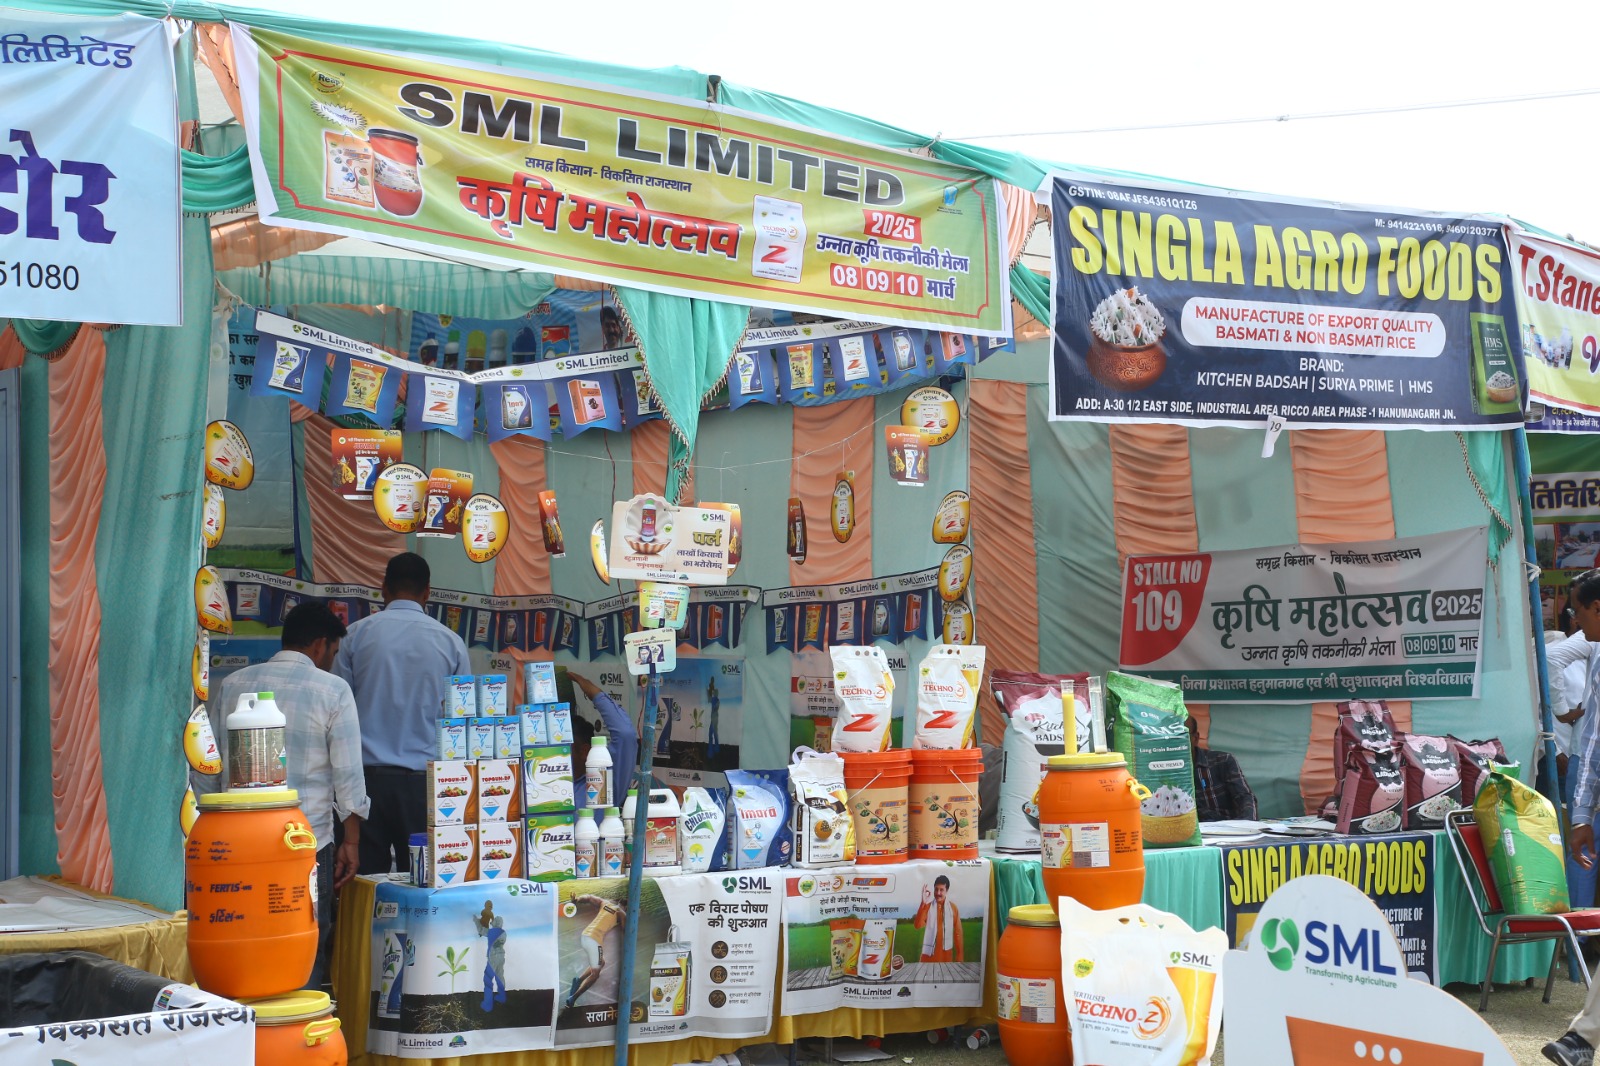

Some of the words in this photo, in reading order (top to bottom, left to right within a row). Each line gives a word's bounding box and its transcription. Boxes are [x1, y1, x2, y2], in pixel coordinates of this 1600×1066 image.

[0, 33, 136, 69] लिमिटेड
[396, 82, 588, 151] SML
[617, 118, 905, 207] LIMITED
[600, 165, 644, 186] विकसित
[645, 173, 692, 193] राजस्थान
[1068, 185, 1106, 200] GSTIN:
[568, 191, 742, 261] महोत्सव
[871, 211, 916, 241] 2025
[1374, 217, 1386, 229] M:
[816, 233, 853, 252] उन्नत
[881, 243, 940, 268] तकनीकी
[941, 250, 969, 274] मेला
[1067, 205, 1246, 286] SINGLA
[1253, 224, 1369, 296] AGRO
[1376, 236, 1503, 304] FOODS
[832, 265, 859, 284] 08
[865, 269, 890, 293] 09
[895, 273, 919, 296] 10
[926, 277, 957, 300] मार्च
[1195, 304, 1305, 326] MANUFACTURE
[1308, 313, 1325, 327] OF
[1327, 314, 1380, 331] EXPORT
[1382, 318, 1433, 334] QUALITY
[301, 325, 327, 342] SML
[328, 334, 373, 355] Limited
[764, 327, 799, 339] Limited
[1215, 325, 1279, 342] BASMATI
[1282, 329, 1293, 342] &
[1296, 330, 1326, 345] NON
[1329, 332, 1384, 348] BASMATI
[1386, 335, 1416, 350] RICE
[1484, 336, 1503, 348] HMS
[566, 359, 589, 371] SML
[589, 352, 630, 368] Limited
[1299, 357, 1345, 373] BRAND:
[1196, 371, 1253, 387] KITCHEN
[1255, 374, 1309, 391] BADSAH
[1318, 378, 1358, 392] SURYA
[1359, 379, 1395, 393] PRIME
[1408, 380, 1433, 394] HMS
[1075, 397, 1102, 411] ADD:
[1103, 398, 1125, 411] A-30
[1142, 400, 1168, 413] EAST
[1169, 401, 1195, 415] SIDE,
[1196, 401, 1251, 415] INDUSTRIAL
[1252, 403, 1279, 416] AREA
[1280, 404, 1310, 417] RICCO
[1311, 405, 1337, 418] AREA
[1338, 406, 1368, 419] PHASE
[1377, 407, 1441, 420] HANUMANGARH
[1442, 408, 1457, 420] JN.
[709, 513, 726, 522] SML
[1283, 551, 1317, 568] किसान
[1330, 550, 1371, 566] विकसित
[1372, 547, 1422, 563] राजस्थान
[246, 571, 263, 580] SML
[262, 574, 292, 587] Limited
[914, 573, 938, 585] Limited
[1133, 561, 1177, 587] STALL
[1179, 559, 1203, 585] NO
[718, 588, 740, 597] Limited
[795, 589, 816, 598] Limited
[856, 583, 879, 593] Limited
[1131, 589, 1183, 632] 109
[1211, 584, 1283, 650] कृषि
[1288, 571, 1432, 638] महोत्सव
[1434, 592, 1483, 617] 2025
[1241, 645, 1280, 662] उन्नत
[1281, 638, 1309, 666] कृषि
[1311, 635, 1368, 660] तकनीकी
[1368, 635, 1397, 658] मेला
[1405, 638, 1420, 653] 08
[1423, 637, 1437, 652] 09
[1440, 636, 1455, 651] 10
[497, 658, 512, 669] SML
[726, 663, 741, 674] SML
[606, 672, 624, 684] SML
[1180, 674, 1208, 691] जिला
[1208, 677, 1249, 692] प्रशासन
[1305, 672, 1323, 691] एवं
[1323, 672, 1339, 689] श्री
[1136, 721, 1186, 736] HMS
[538, 763, 570, 774] Buzz
[541, 832, 573, 844] Buzz
[1364, 840, 1427, 897] FOODS
[520, 883, 549, 895] SML
[738, 876, 772, 891] SML
[688, 902, 706, 917] एक
[708, 899, 740, 914] विराट
[740, 900, 769, 915] पोषण
[1380, 907, 1413, 923] FACTURE
[1413, 907, 1424, 922] OF
[707, 917, 725, 929] की
[727, 917, 768, 932] शुरुआत
[1304, 919, 1398, 976] SML
[1420, 939, 1427, 950] &
[1181, 951, 1213, 967] SML
[1407, 952, 1425, 967] RICE
[1304, 966, 1354, 984] Transforming
[1354, 974, 1398, 989] Agriculture
[843, 986, 862, 996] SML
[862, 987, 892, 996] Limited
[1073, 990, 1107, 1003] FERTILISER
[653, 1023, 676, 1033] Limited
[409, 1038, 444, 1048] Limited
